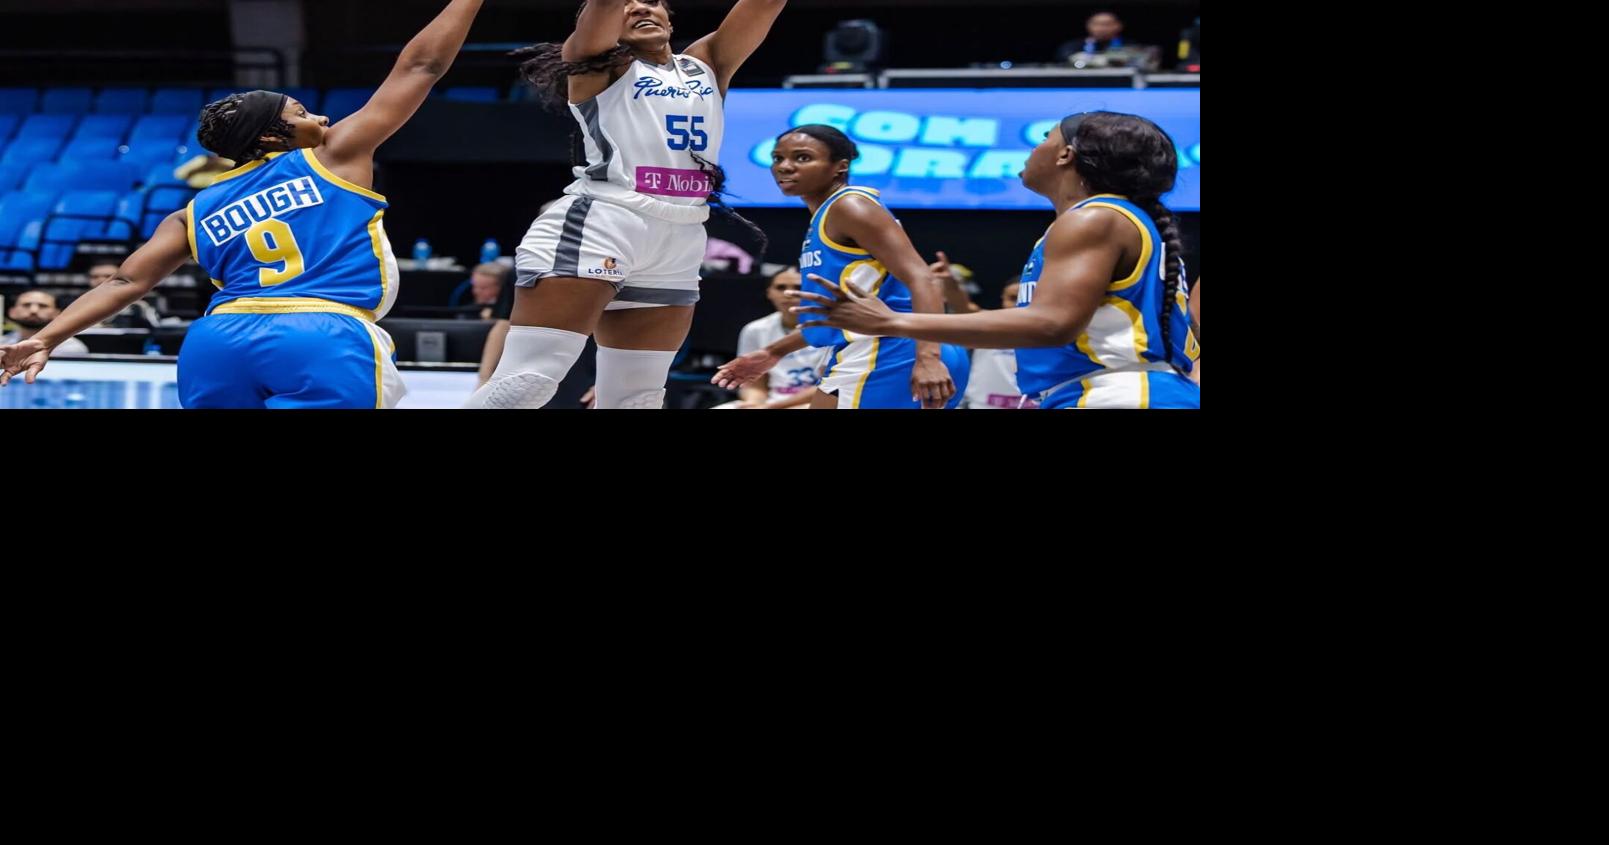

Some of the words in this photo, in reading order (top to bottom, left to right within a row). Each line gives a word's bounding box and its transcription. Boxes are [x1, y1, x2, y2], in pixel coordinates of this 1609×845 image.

[685, 80, 714, 101] Ric
[665, 114, 708, 151] 55
[204, 178, 320, 244] BOUGH
[244, 217, 305, 287] 9
